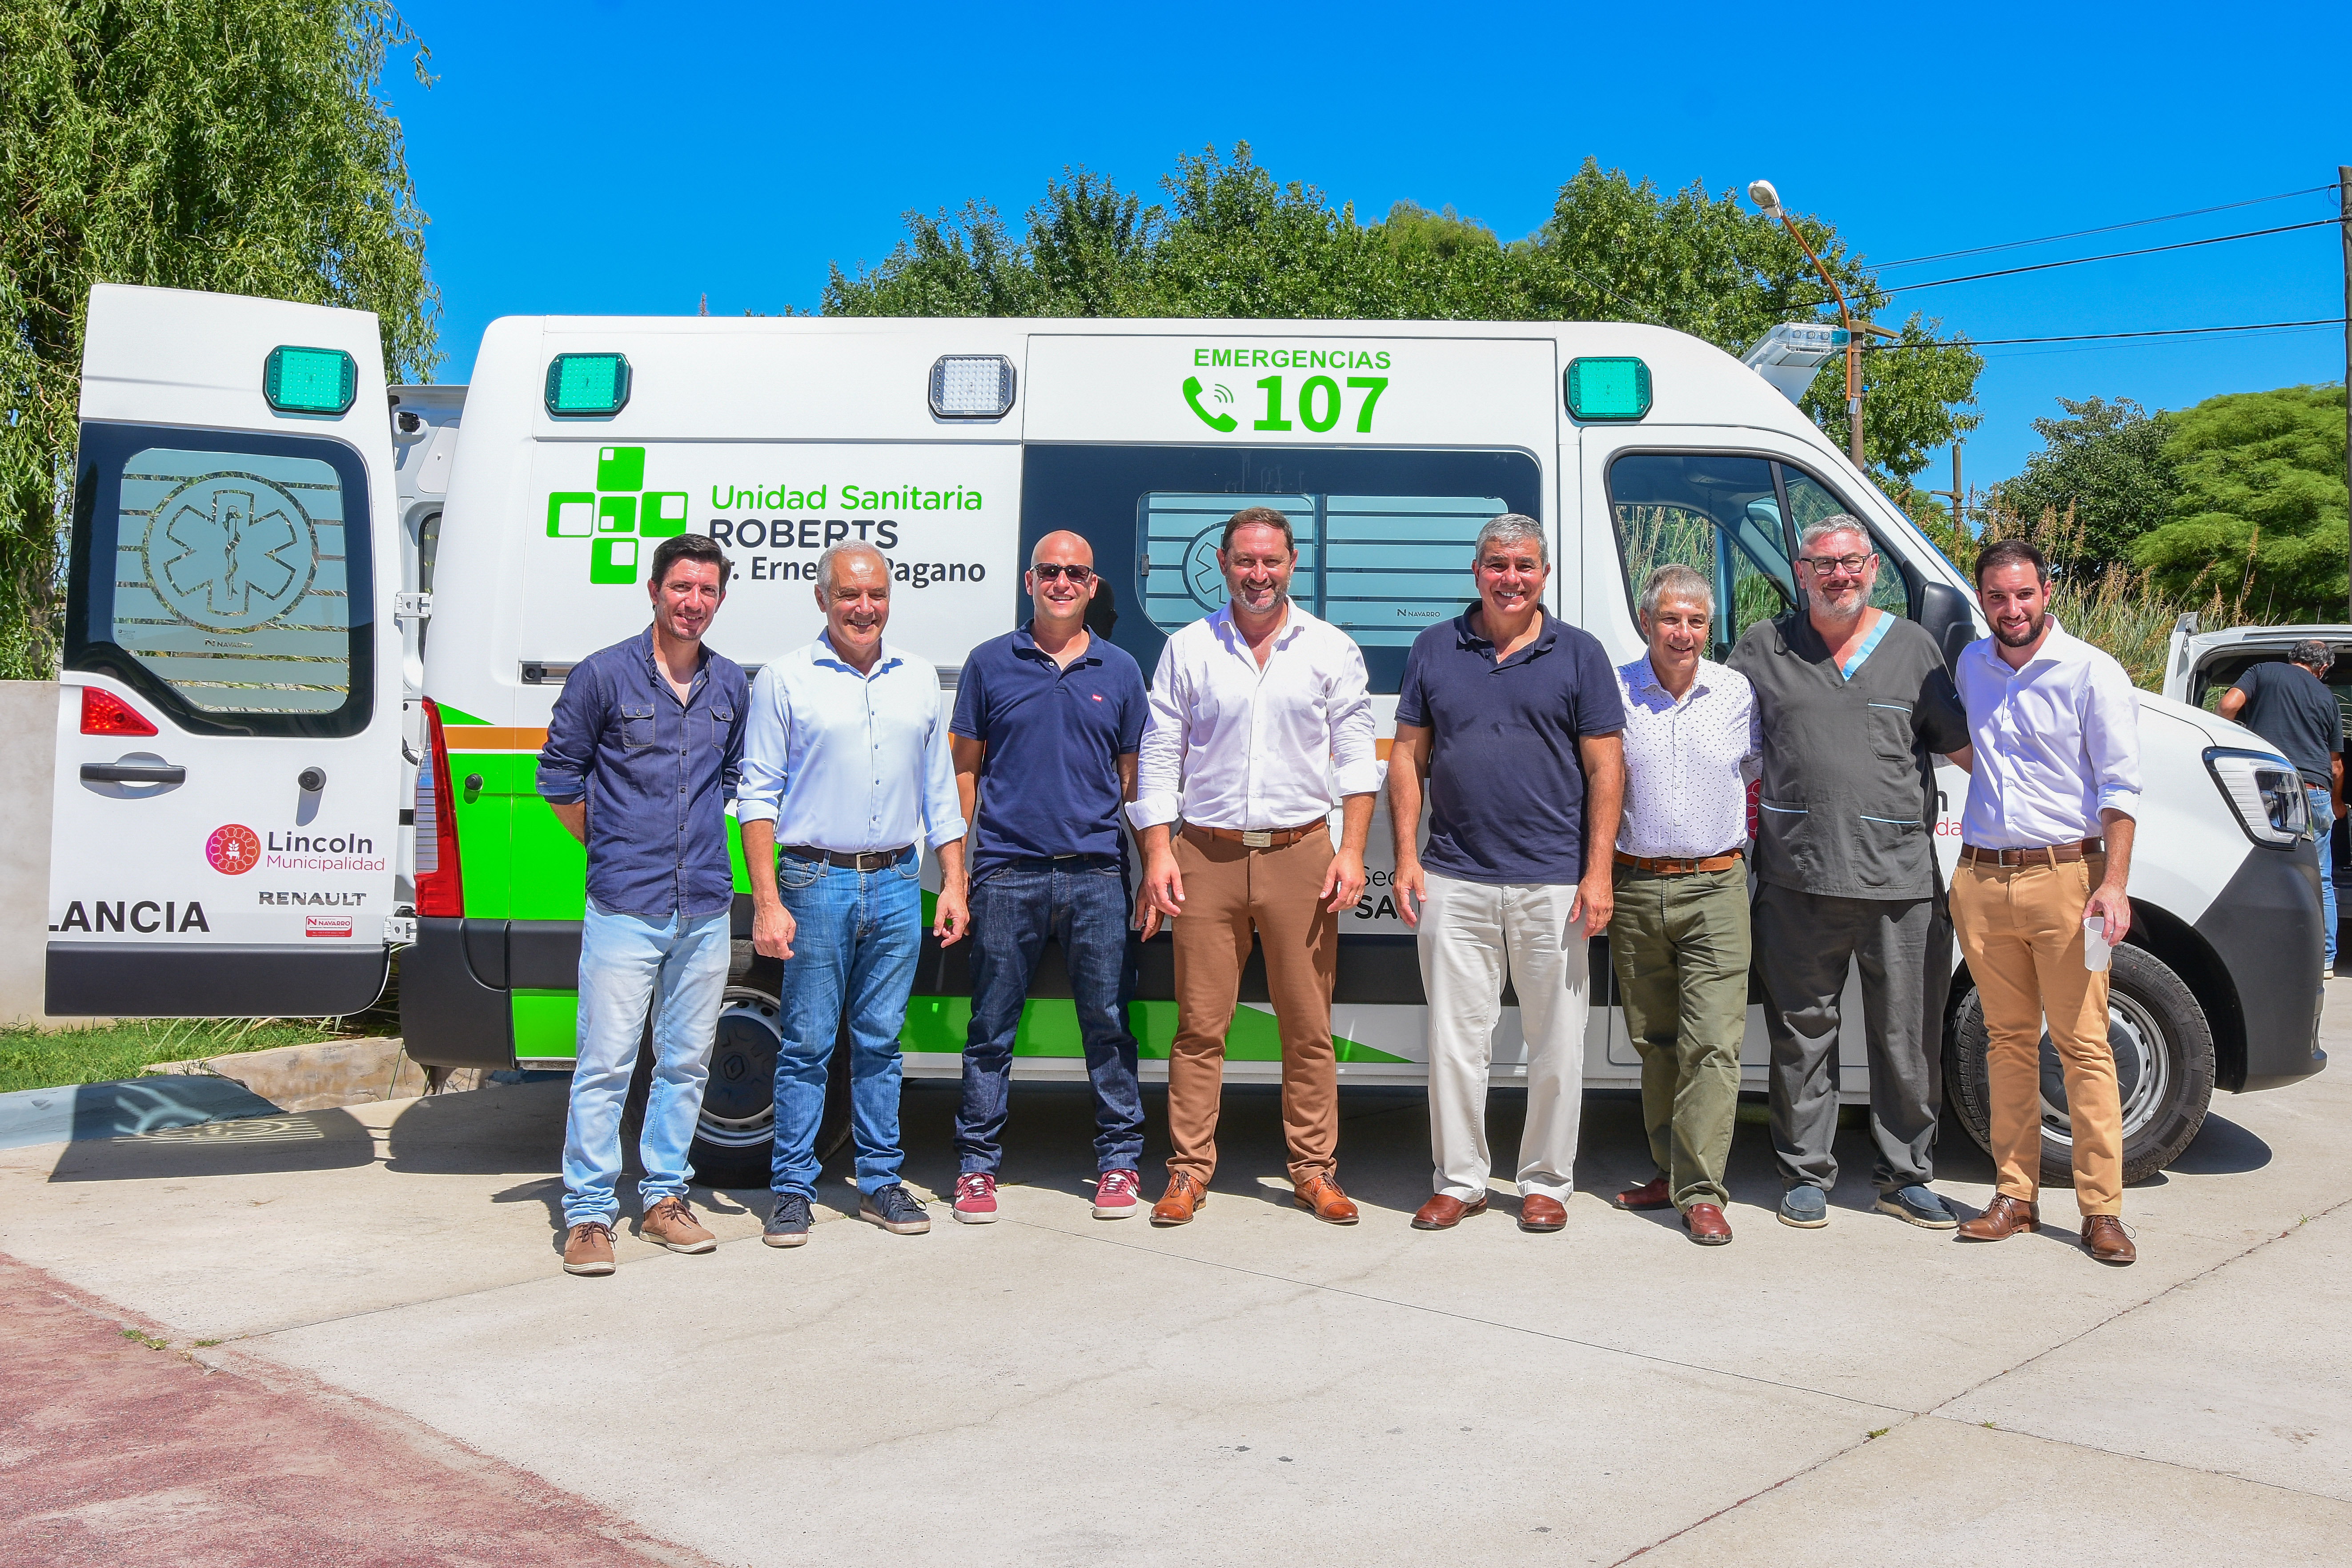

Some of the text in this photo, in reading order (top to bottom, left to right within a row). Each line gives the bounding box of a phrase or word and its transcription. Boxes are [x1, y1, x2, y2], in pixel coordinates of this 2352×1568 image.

[1194, 349, 1391, 369] EMERGENCIAS
[1253, 375, 1388, 433] 107
[711, 484, 982, 510] Unidad Sanitaria
[709, 518, 898, 549] ROBERTS
[751, 556, 818, 581] Erne
[885, 557, 986, 589] agano
[268, 831, 372, 854] Lincoln
[267, 854, 385, 872] Municipalidad
[259, 891, 367, 906] RENAULT
